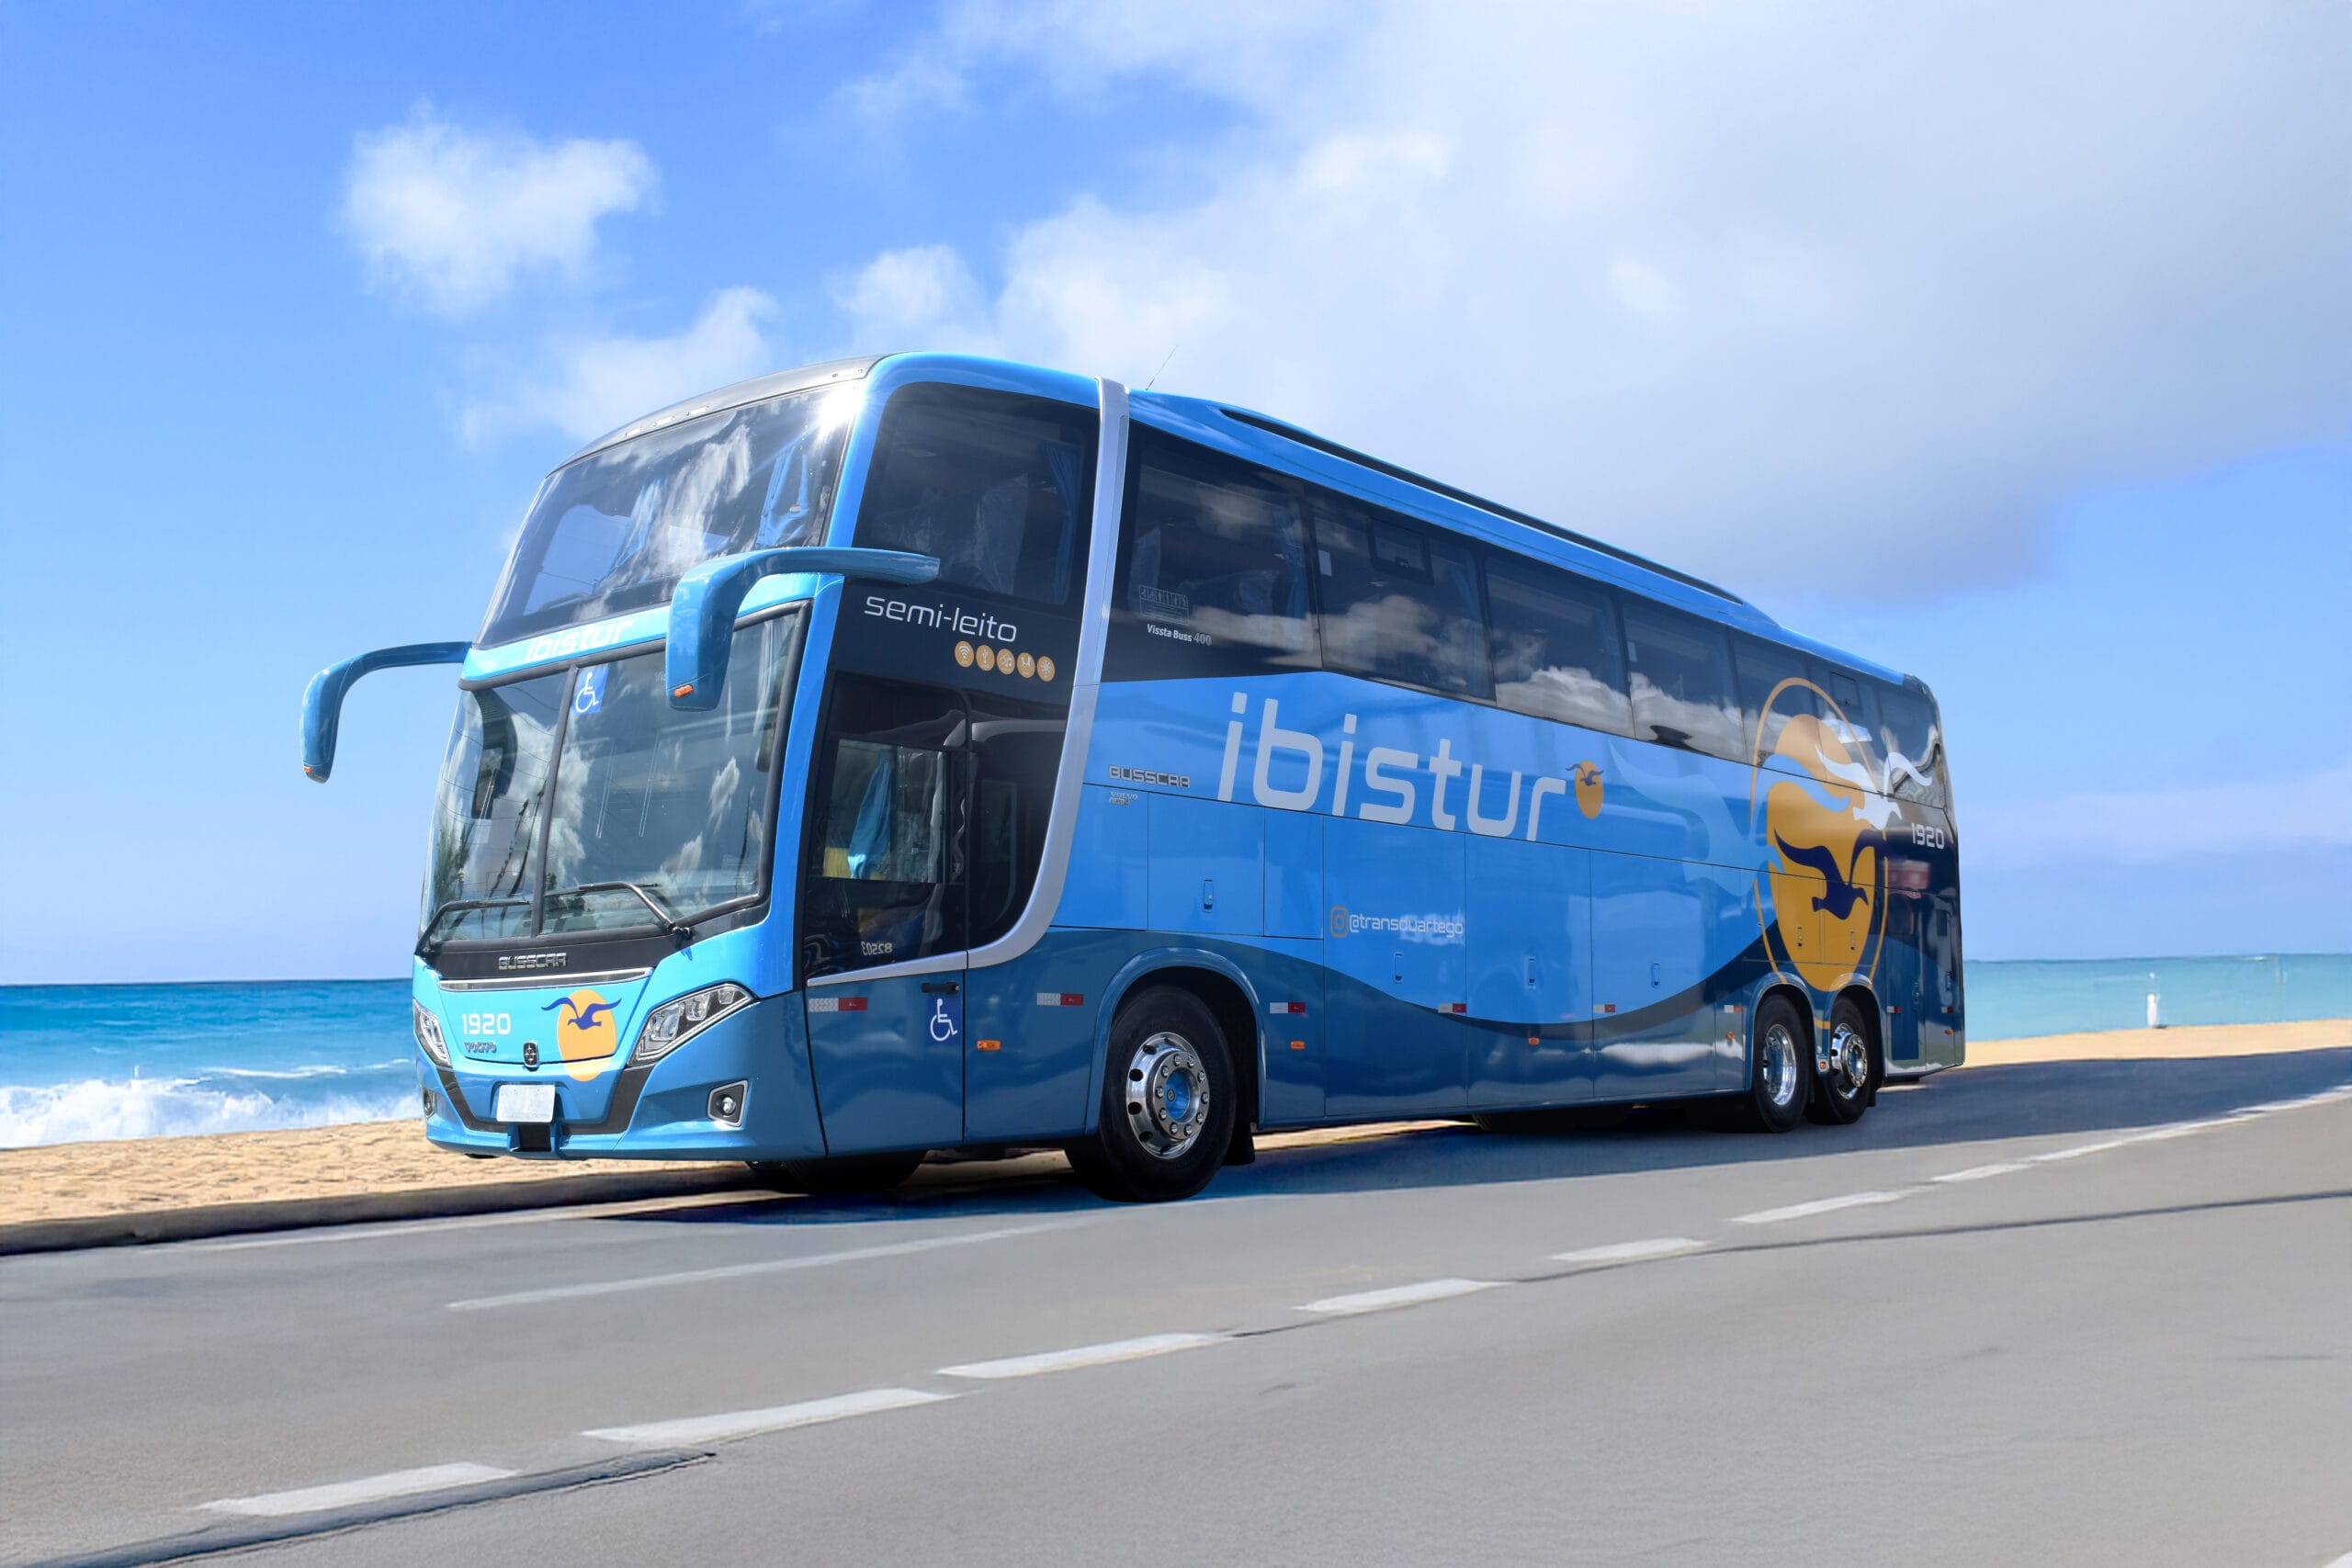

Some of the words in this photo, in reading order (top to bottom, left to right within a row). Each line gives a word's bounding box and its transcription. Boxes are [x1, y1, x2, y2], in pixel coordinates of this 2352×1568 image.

[864, 596, 1017, 642] semi-leito
[525, 620, 633, 664] ibistur
[1147, 624, 1172, 638] Vissta
[1172, 630, 1193, 642] Buss
[1193, 632, 1212, 646] 400
[1109, 764, 1190, 788] BUSSCAR
[1217, 692, 1566, 842] ibistur
[1911, 823, 1945, 850] 1920
[1350, 913, 1464, 939] @transduartego
[499, 953, 567, 971] BUSSCAR
[462, 1013, 511, 1035] 1920
[464, 1042, 497, 1054] VOLVO
